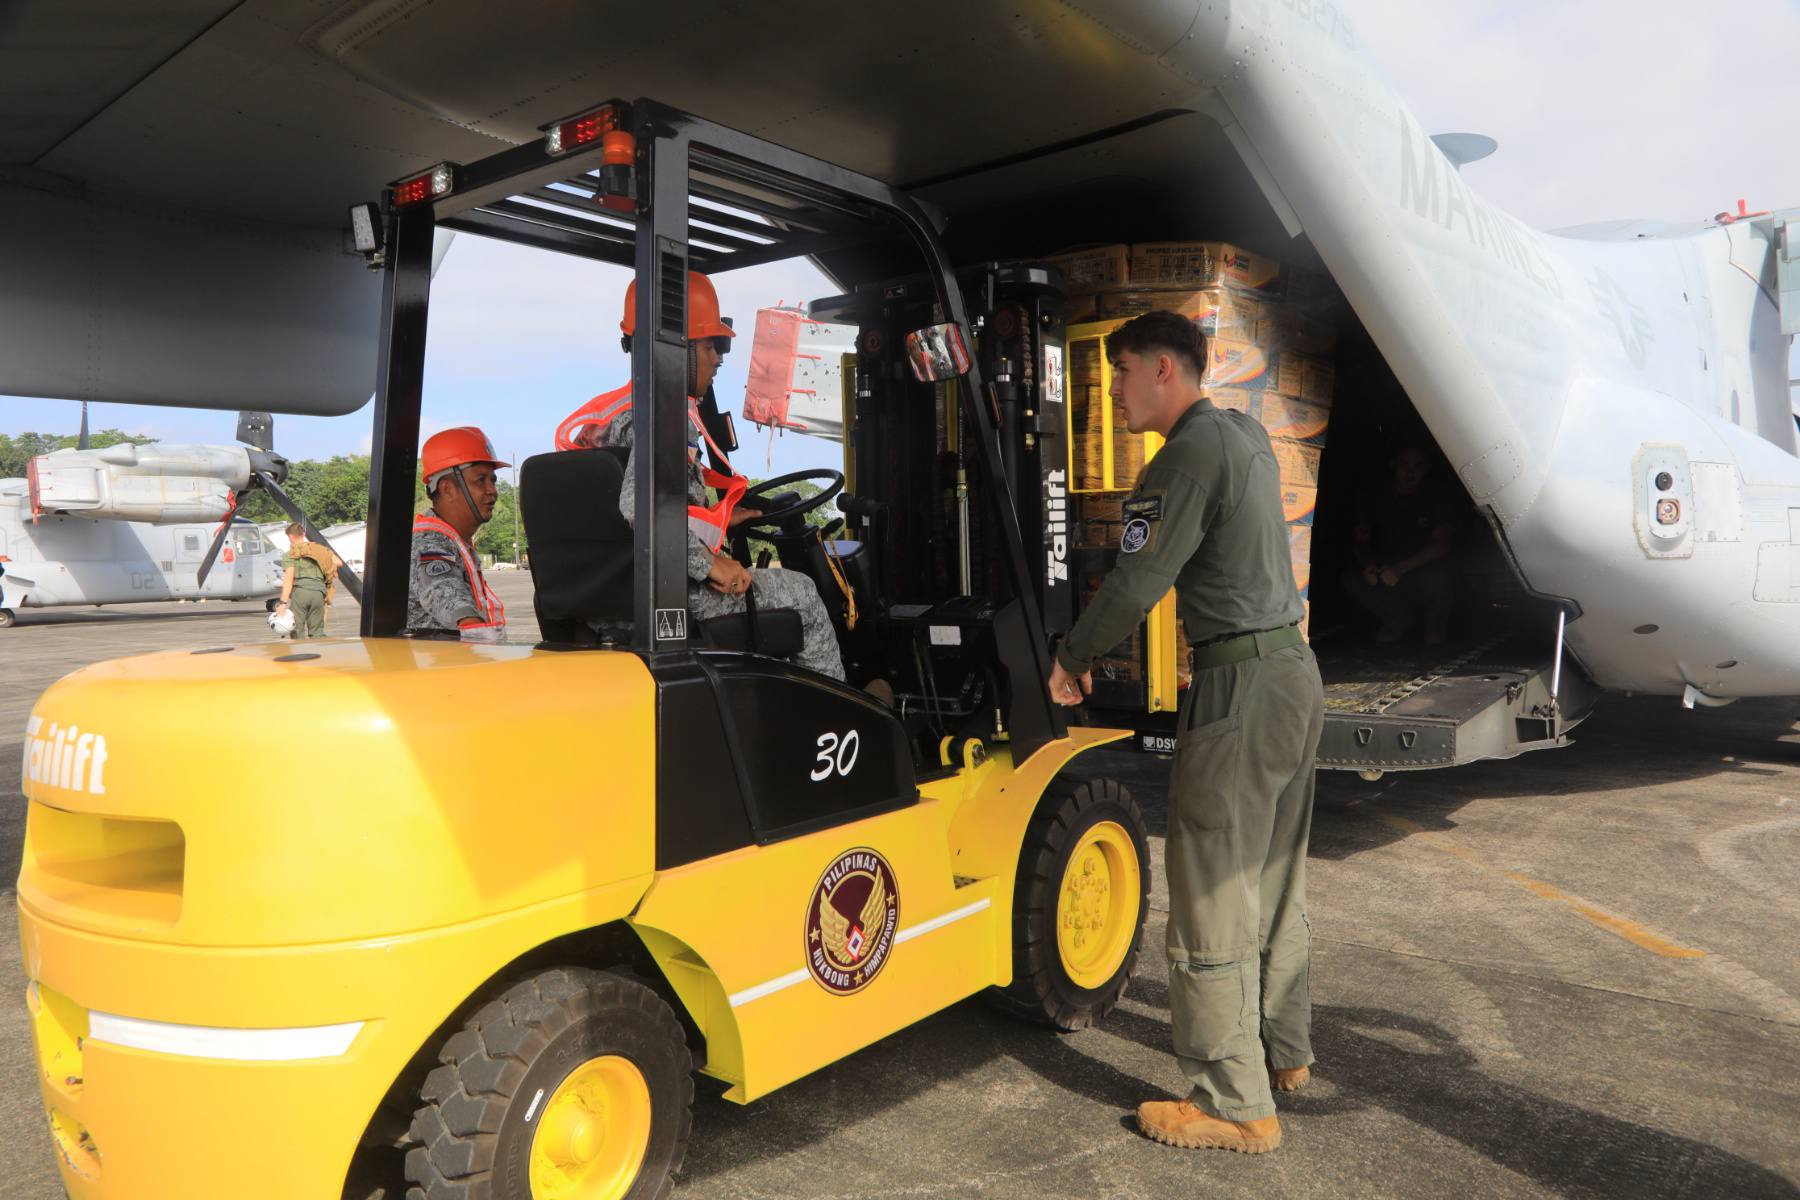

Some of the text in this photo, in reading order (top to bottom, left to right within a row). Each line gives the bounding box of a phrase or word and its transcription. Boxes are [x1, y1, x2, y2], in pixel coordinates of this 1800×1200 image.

[1047, 468, 1068, 586] Tailift
[810, 729, 859, 781] 30
[823, 854, 877, 890] PILIPINAS
[813, 908, 896, 986] HUKBONG HIMPAPAWID
